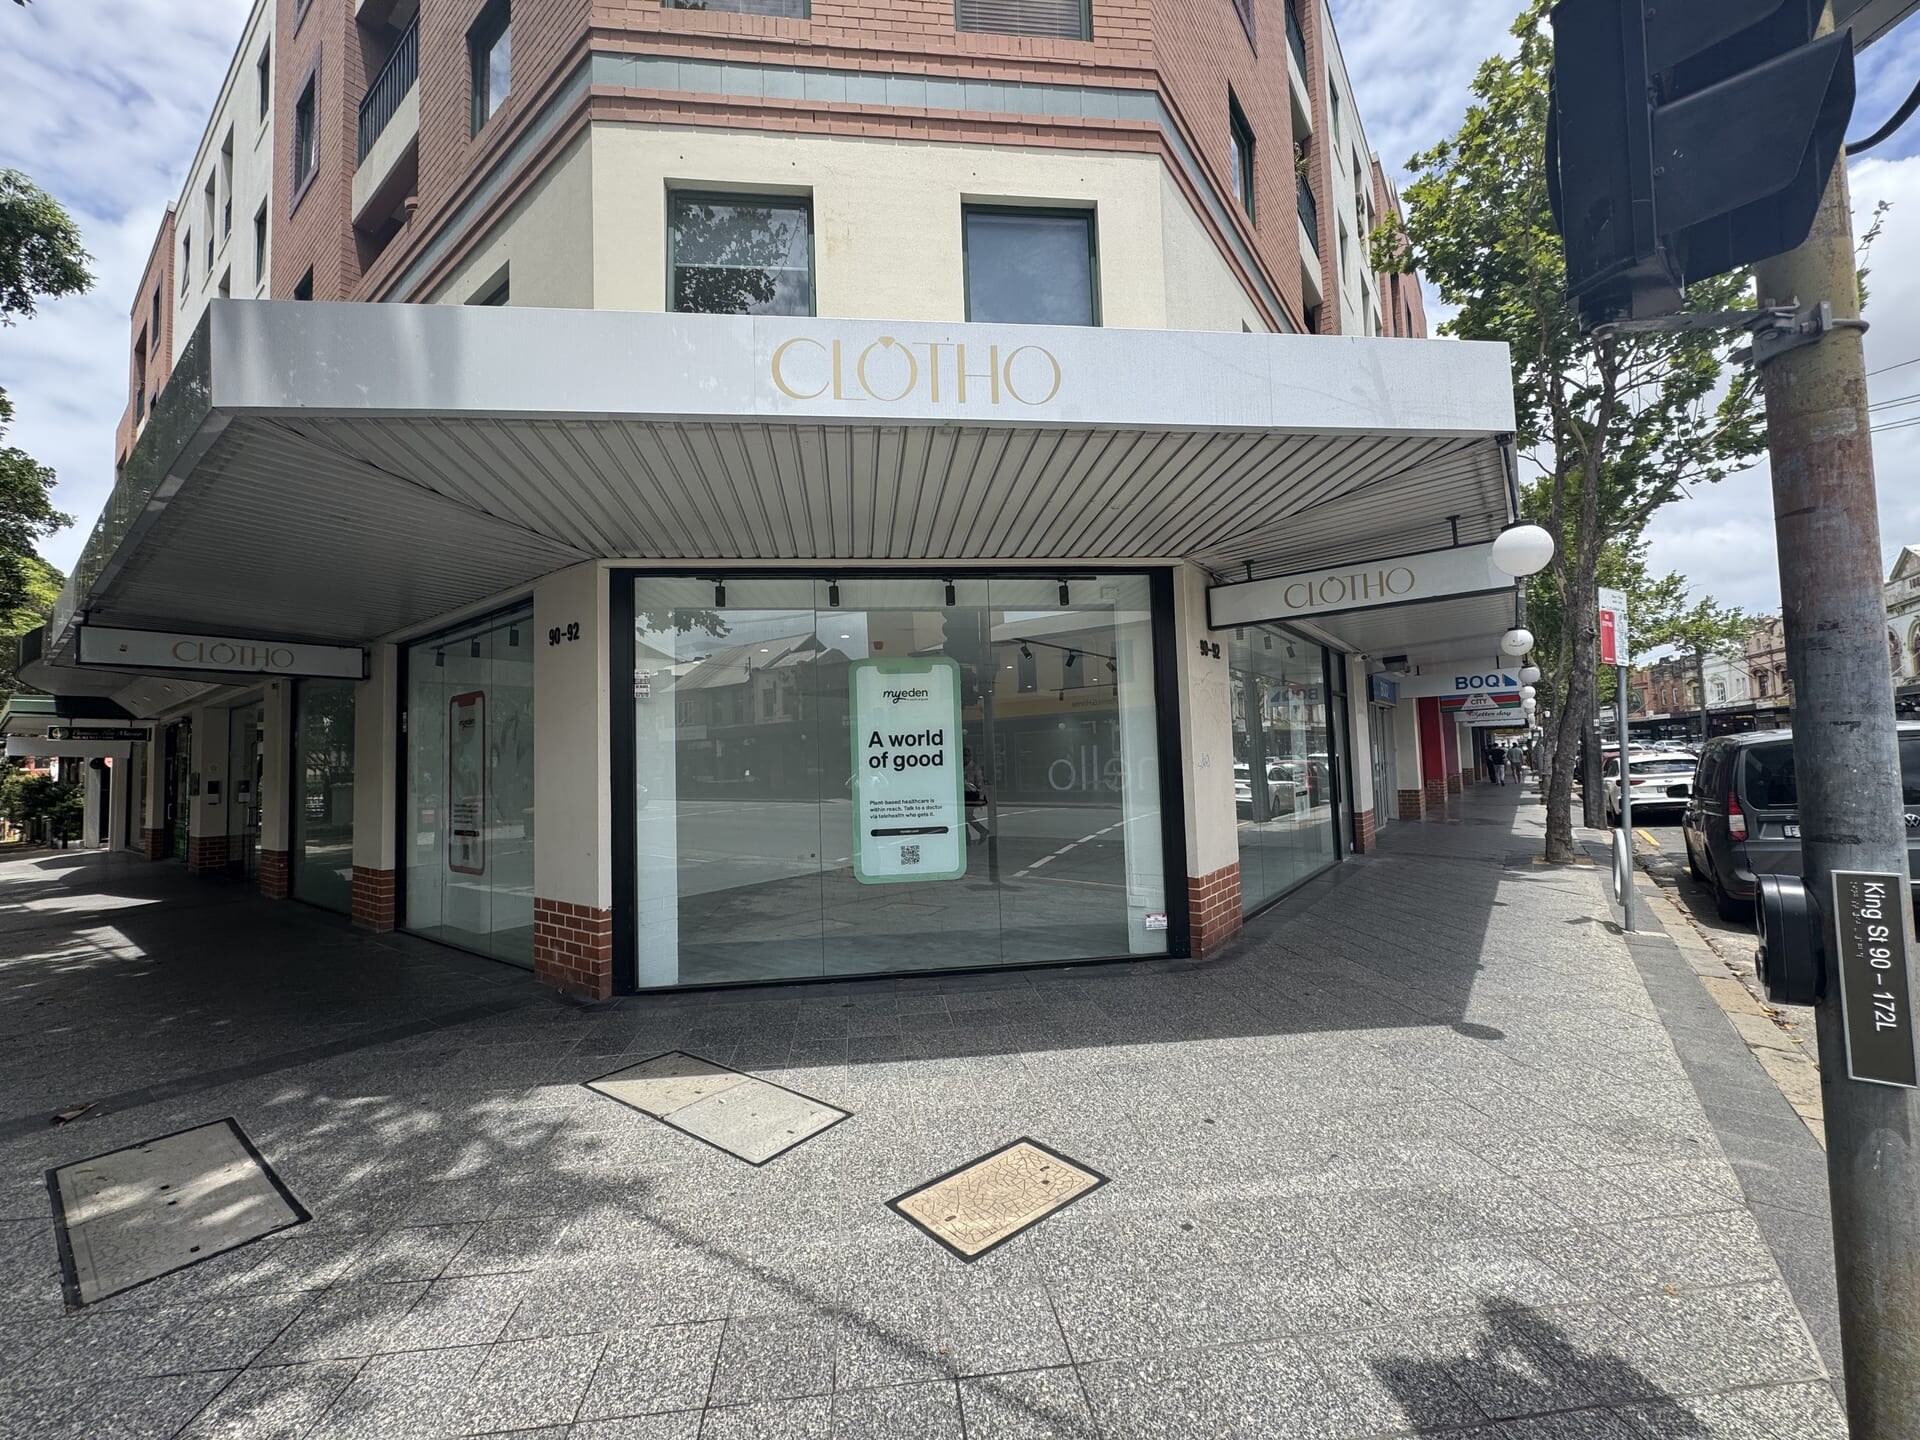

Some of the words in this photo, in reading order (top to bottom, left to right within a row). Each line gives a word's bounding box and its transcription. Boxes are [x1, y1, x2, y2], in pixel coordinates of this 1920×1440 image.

[771, 336, 1062, 405] CLOTHO
[1283, 567, 1415, 609] CLOTHO
[548, 621, 580, 646] 90-92
[172, 641, 294, 668] CLOTHO
[1455, 674, 1500, 690] BOQ
[882, 688, 929, 704] myeden
[868, 731, 884, 748] A
[888, 729, 944, 747] world
[868, 751, 889, 769] of
[893, 749, 944, 772] good
[917, 811, 929, 819] gets
[1861, 881, 1885, 920] King
[1867, 925, 1889, 943] St
[1869, 949, 1891, 969] 90
[1872, 991, 1897, 1032] 172L
